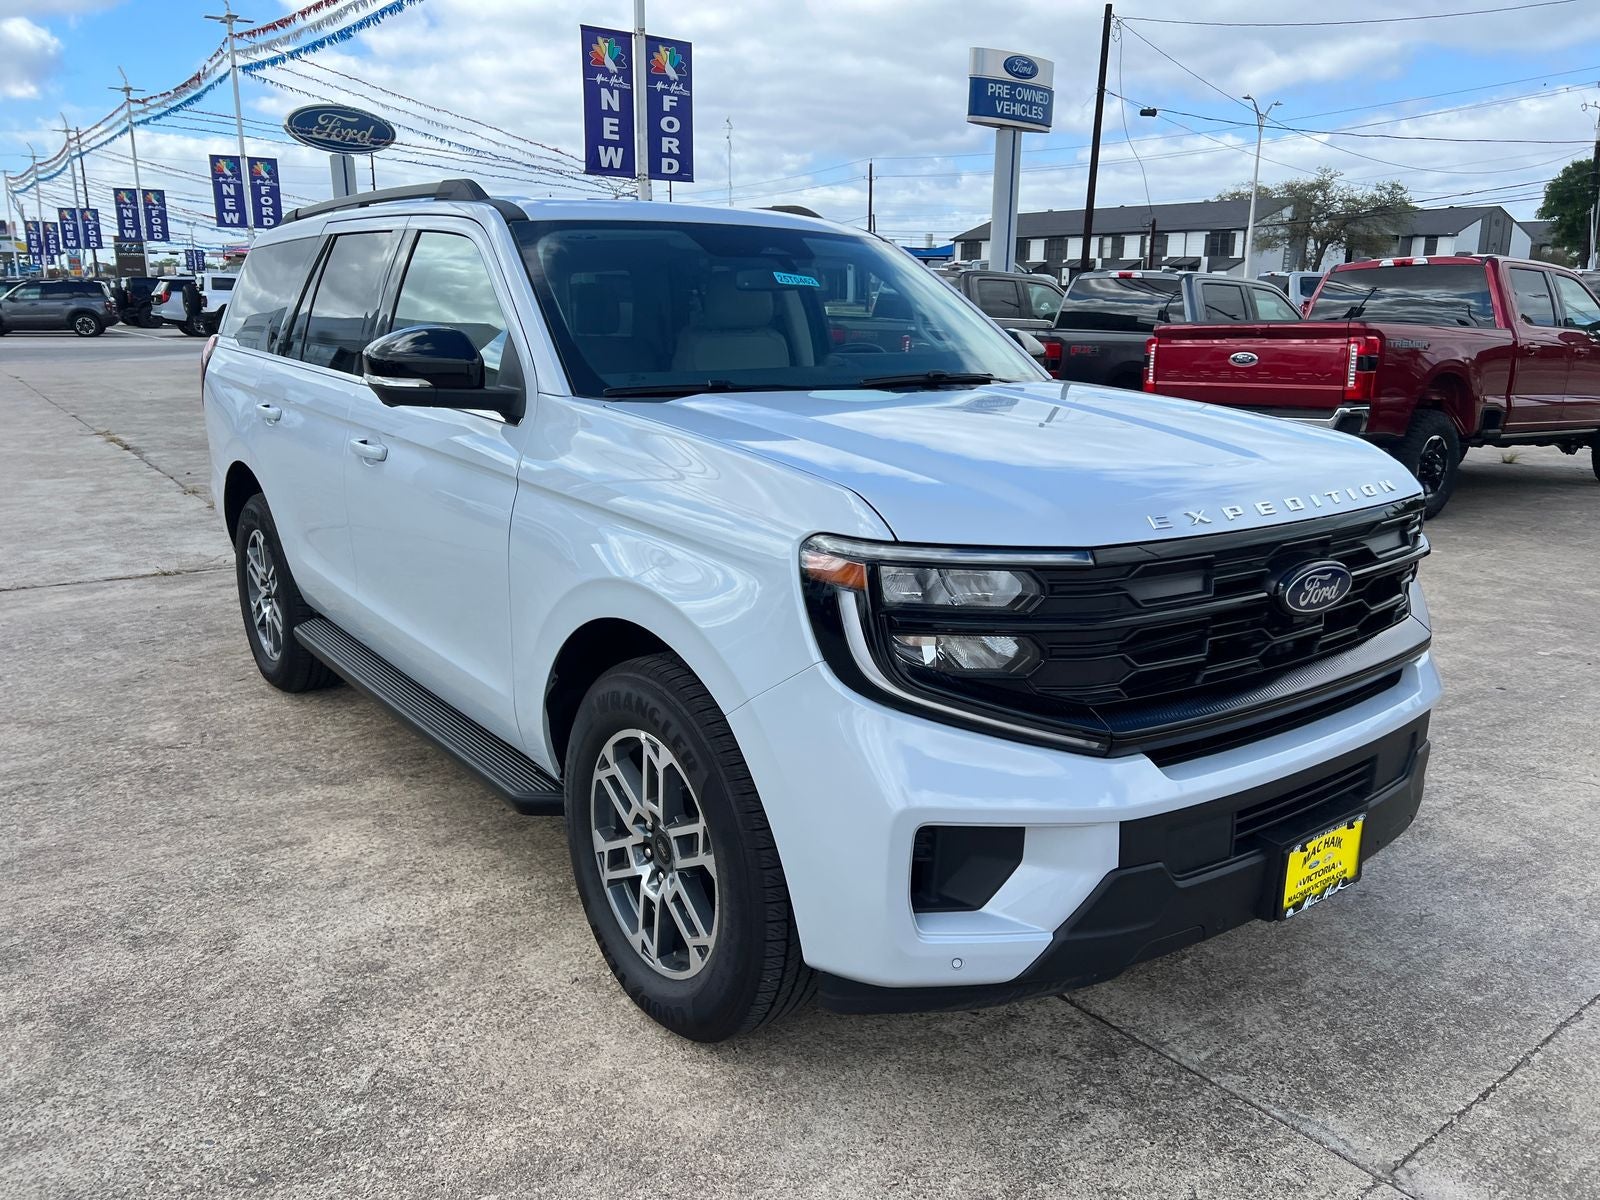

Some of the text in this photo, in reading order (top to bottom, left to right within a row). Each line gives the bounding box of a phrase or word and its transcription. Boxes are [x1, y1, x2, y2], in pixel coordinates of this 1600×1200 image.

[1012, 58, 1033, 74] Ford
[987, 82, 1049, 105] PRE-OWNED
[995, 100, 1044, 119] VEHICLES
[312, 113, 374, 147] Ford
[597, 87, 624, 169] NEW
[660, 95, 681, 174] FORD
[221, 183, 240, 224] NEW
[260, 186, 274, 226] FORD
[64, 223, 77, 247] NEW
[87, 224, 98, 248] FORD
[122, 208, 136, 238] NEW
[151, 209, 163, 240] FORD
[30, 234, 39, 253] NEW
[1389, 339, 1429, 349] TREMOR
[1147, 479, 1397, 531] EXPEDITION
[1299, 572, 1342, 607] Ford
[595, 691, 699, 774] WRANGLER
[1302, 836, 1343, 868] MAC HAIK
